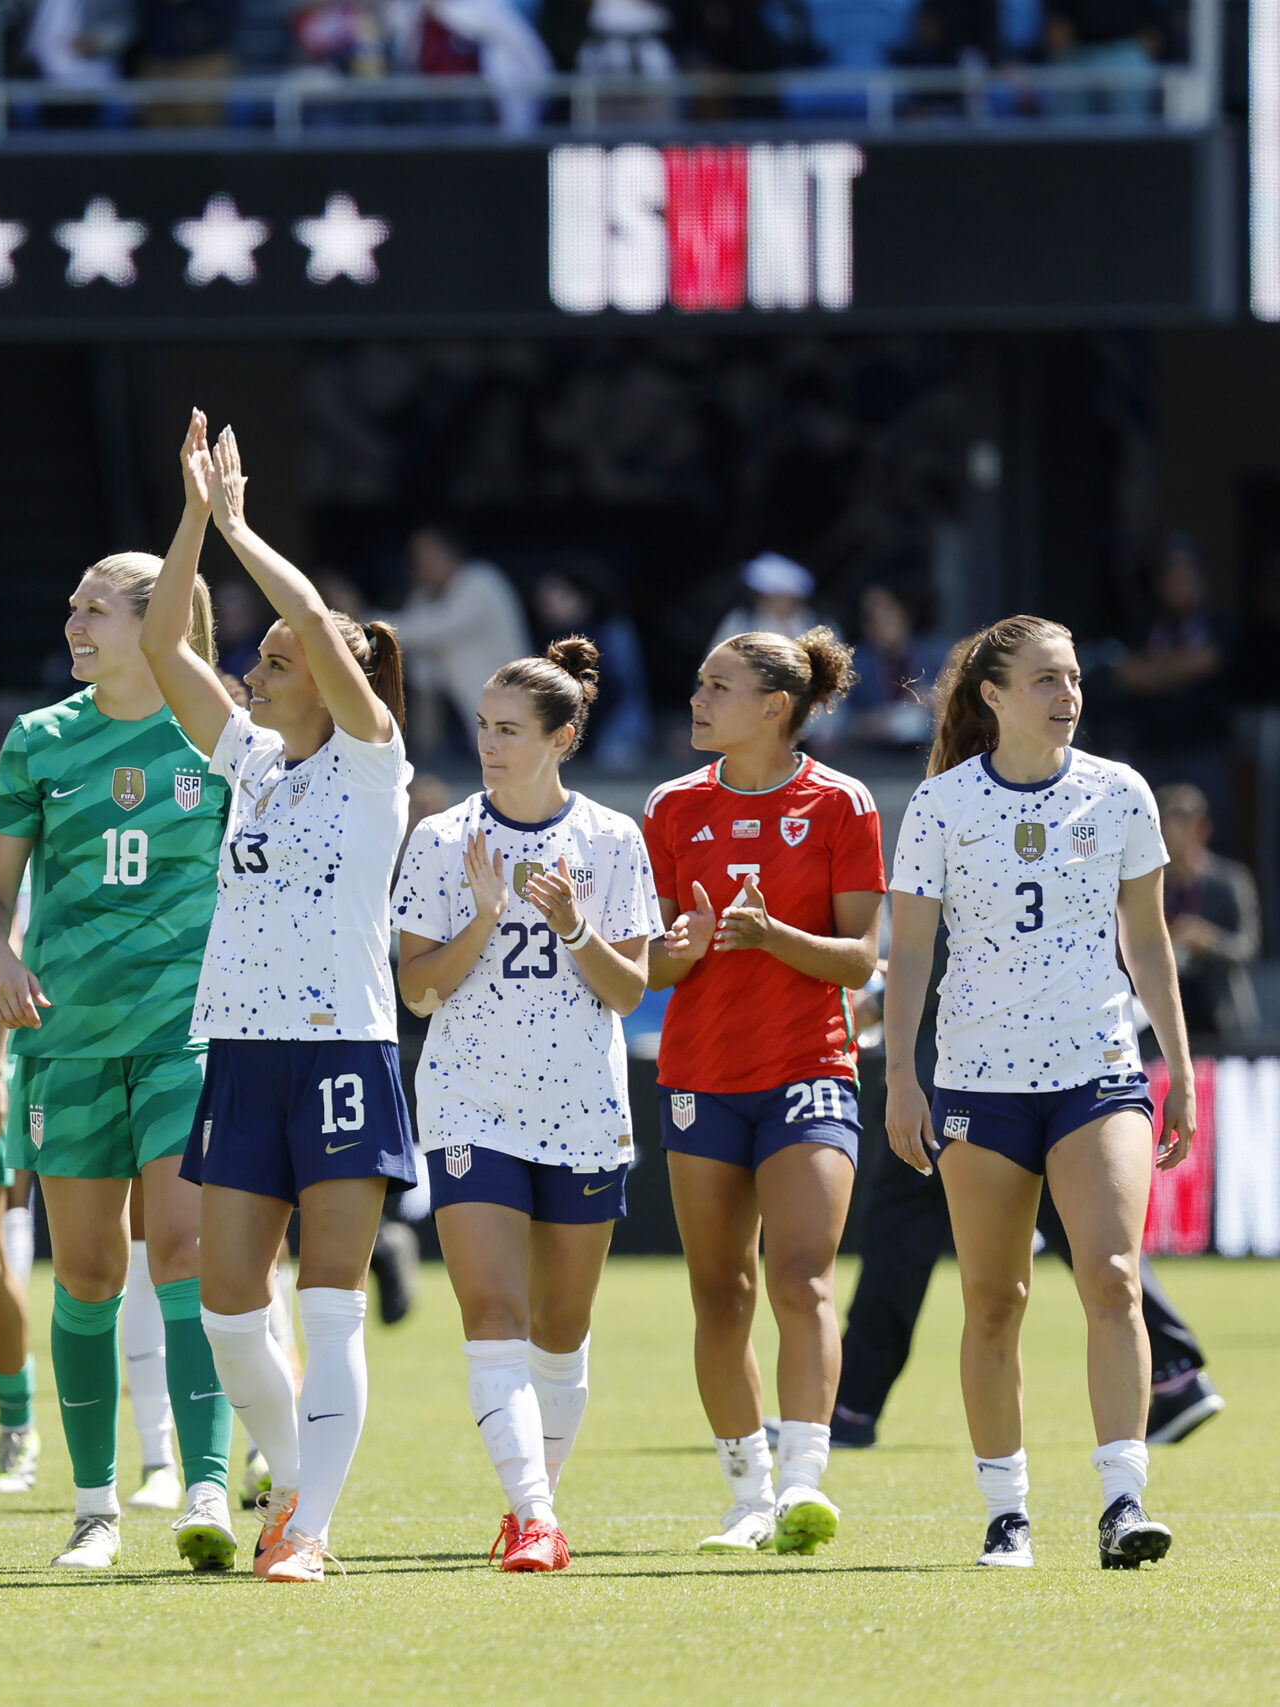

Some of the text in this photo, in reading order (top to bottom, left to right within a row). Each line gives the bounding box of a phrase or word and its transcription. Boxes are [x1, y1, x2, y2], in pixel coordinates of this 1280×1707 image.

[177, 777, 200, 791] USA
[229, 828, 269, 874] 13
[1072, 826, 1095, 841] USA
[102, 828, 148, 885] 18
[1015, 881, 1044, 934] 3
[500, 922, 558, 979] 23
[318, 1073, 365, 1134] 13
[673, 1094, 693, 1110] USA
[785, 1079, 843, 1123] 20
[946, 1117, 968, 1132] USA
[447, 1145, 469, 1158] USA
